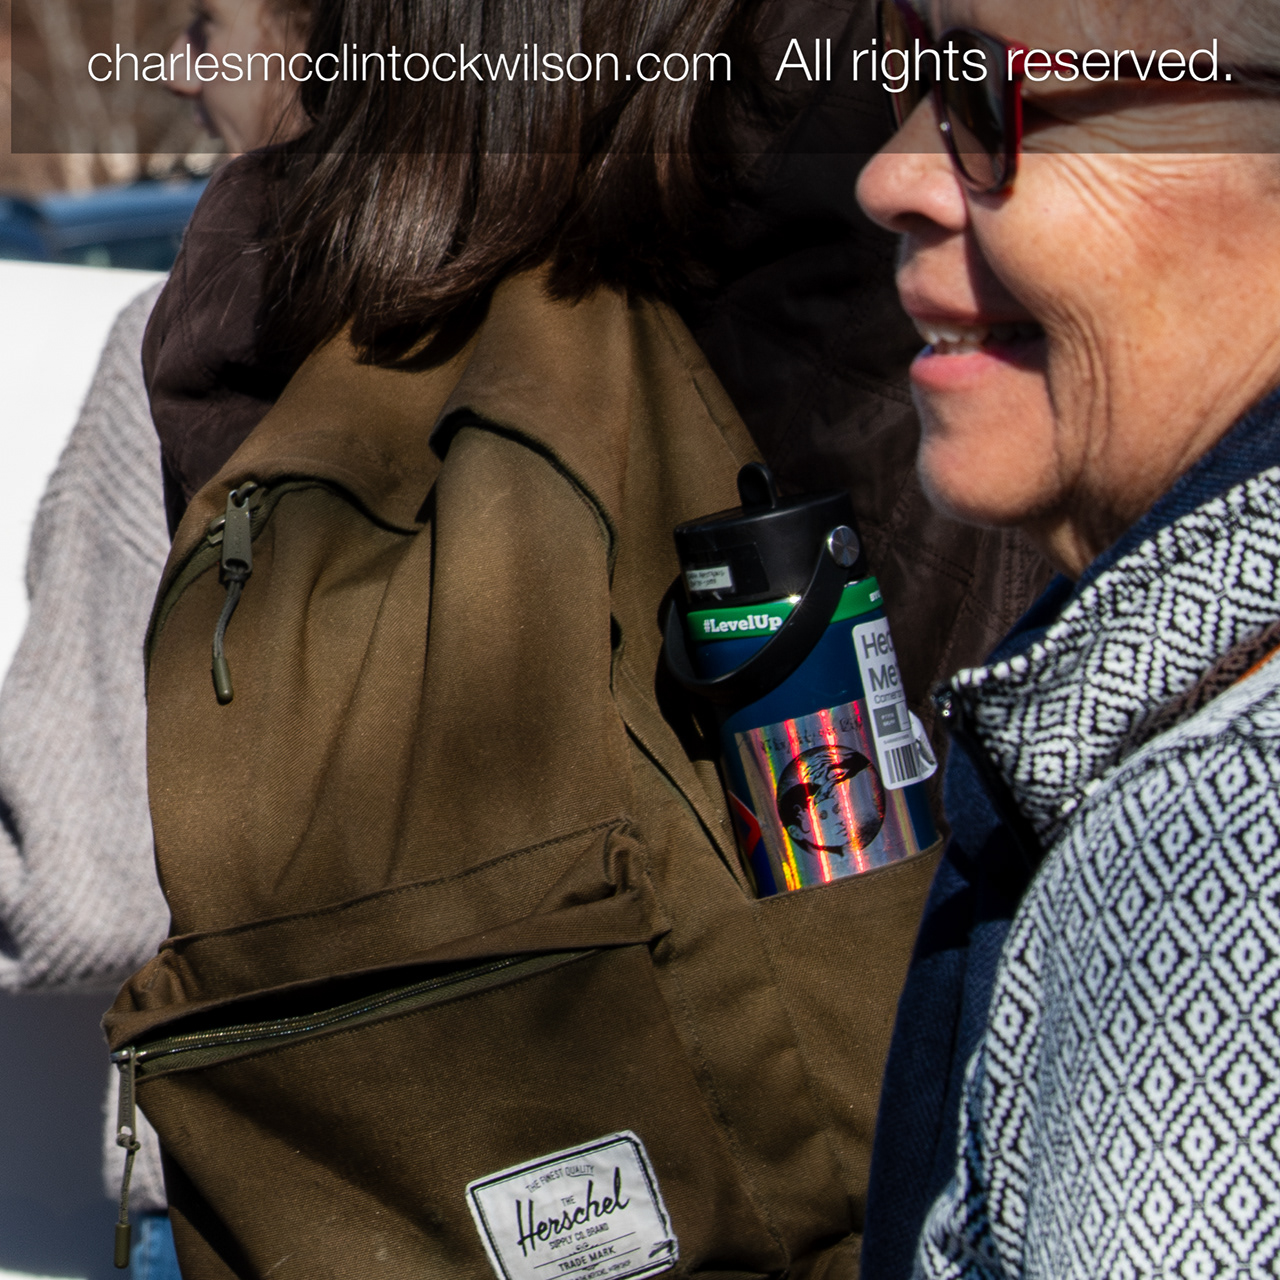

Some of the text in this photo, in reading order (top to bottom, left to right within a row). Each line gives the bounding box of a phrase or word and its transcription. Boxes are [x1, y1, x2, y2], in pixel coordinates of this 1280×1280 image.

[703, 614, 784, 633] #LevelUp
[868, 663, 900, 692] Me
[525, 1164, 595, 1194] THE FINEST QUALITY
[515, 1166, 632, 1258] Herschel
[560, 1195, 577, 1207] THE
[548, 1235, 574, 1251] SUPPLY
[586, 1222, 610, 1238] BRAND
[558, 1244, 617, 1272] TRADE MARK
